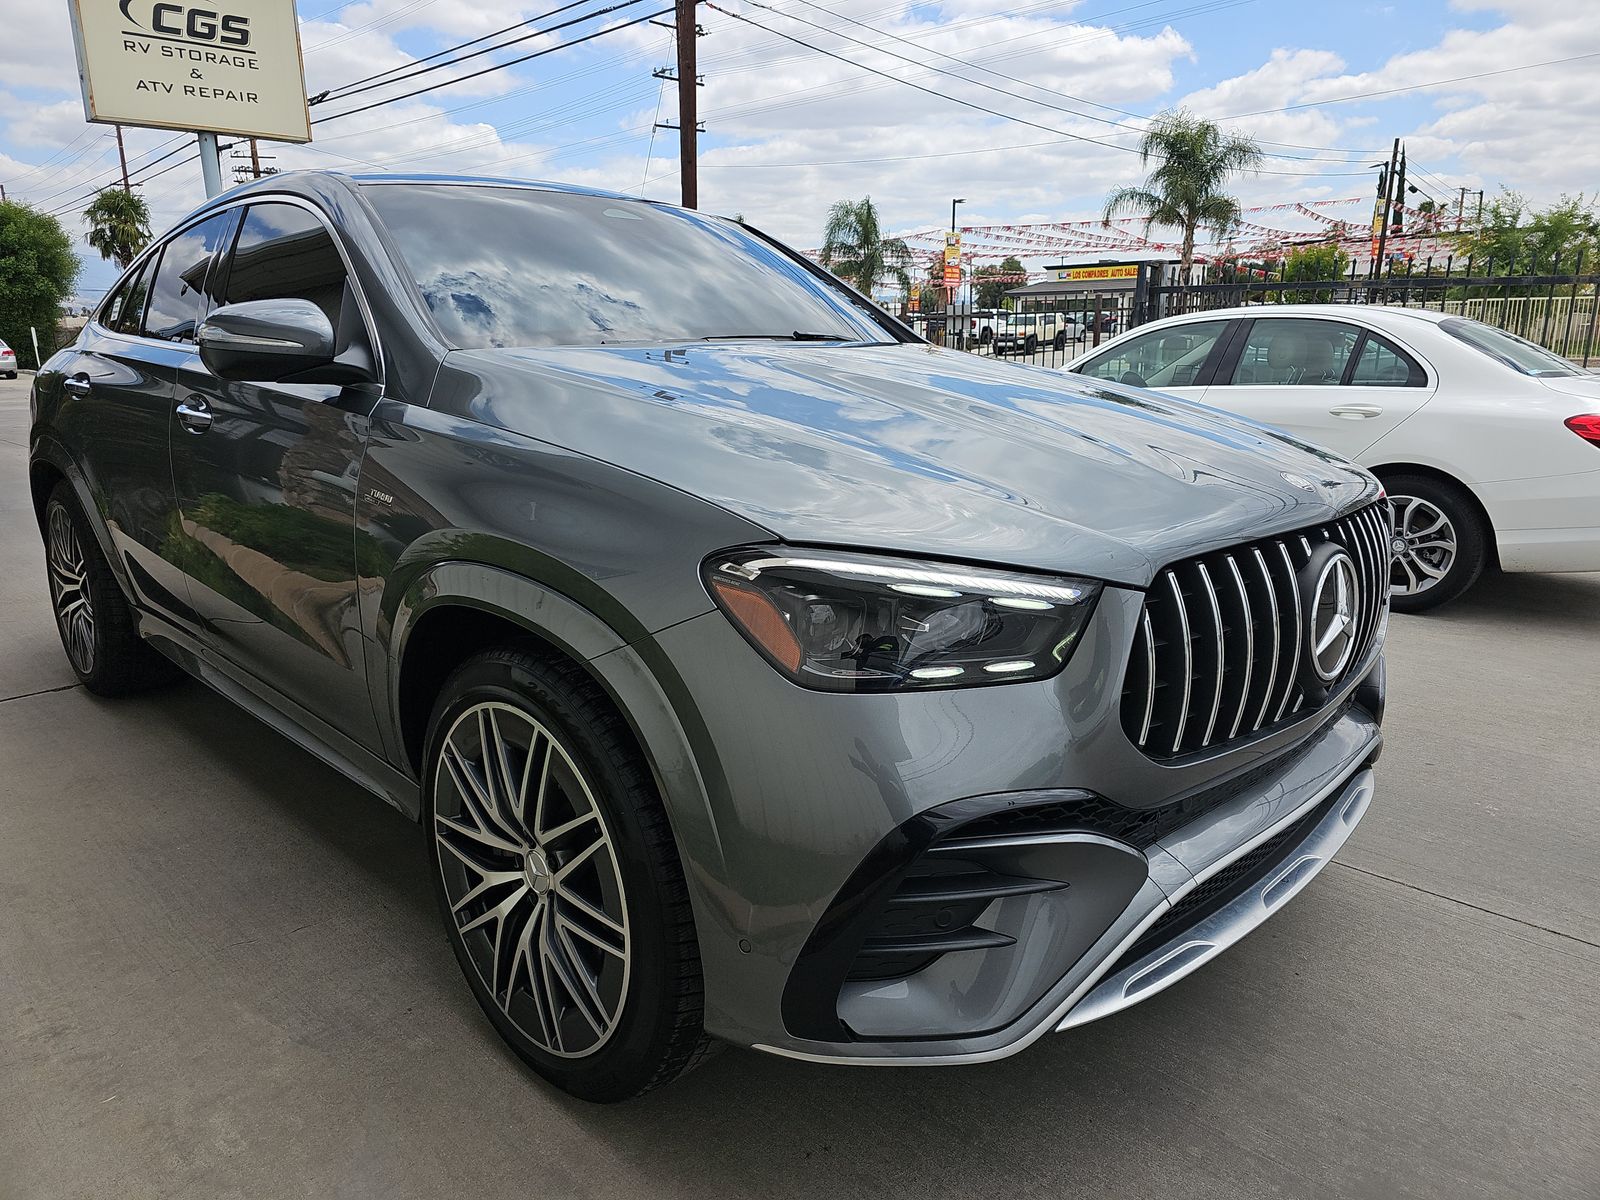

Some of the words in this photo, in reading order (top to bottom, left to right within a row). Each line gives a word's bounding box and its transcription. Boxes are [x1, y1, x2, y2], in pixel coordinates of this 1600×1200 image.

[152, 3, 251, 47] CGS
[123, 40, 151, 54] RV
[161, 45, 259, 70] STORAGE
[190, 68, 203, 80] &
[136, 79, 173, 94] ATV
[183, 84, 259, 104] REPAIR
[1072, 270, 1081, 280] LOS
[1082, 269, 1109, 279] COMPADRES
[1111, 268, 1123, 278] AUTO
